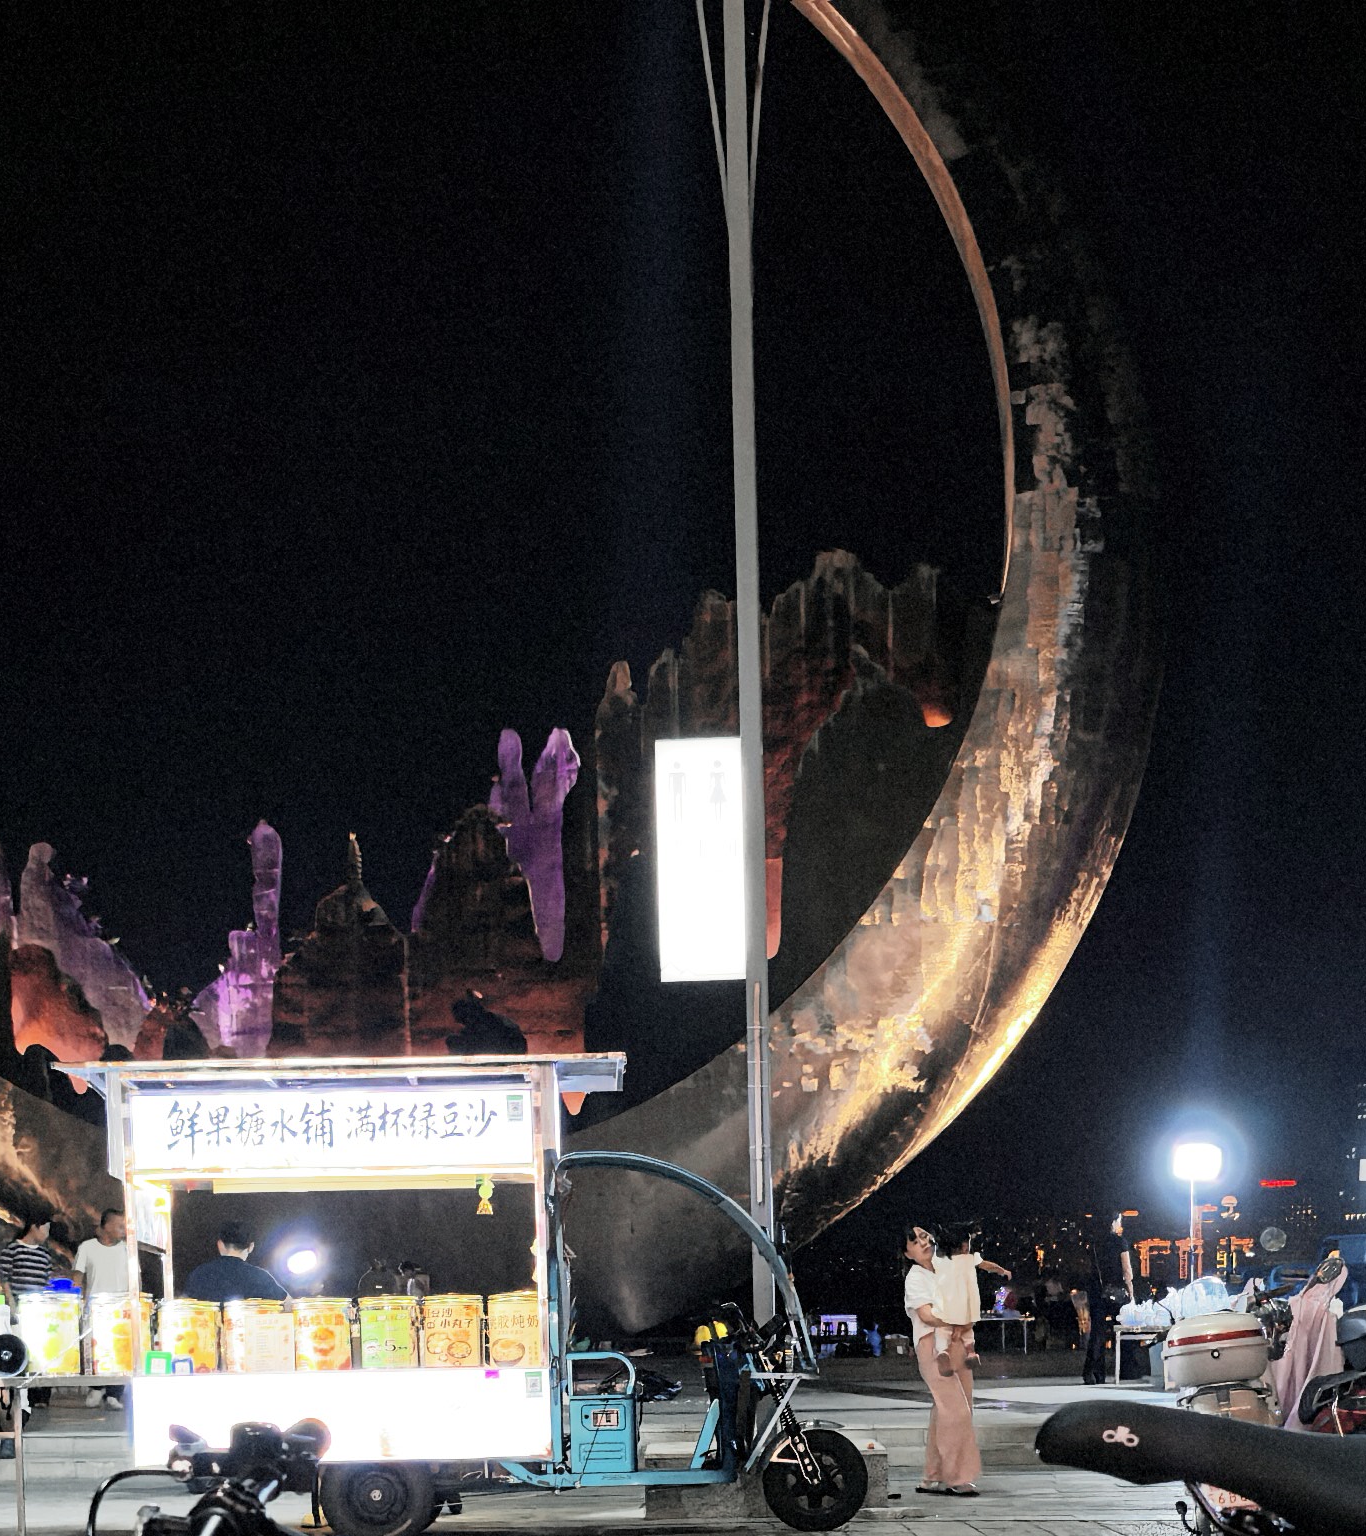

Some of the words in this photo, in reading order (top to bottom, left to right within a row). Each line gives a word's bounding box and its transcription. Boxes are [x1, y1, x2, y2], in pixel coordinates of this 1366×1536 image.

[167, 1100, 334, 1159] 鲜果糖水铺
[346, 1099, 498, 1143] 满杯绿豆沙
